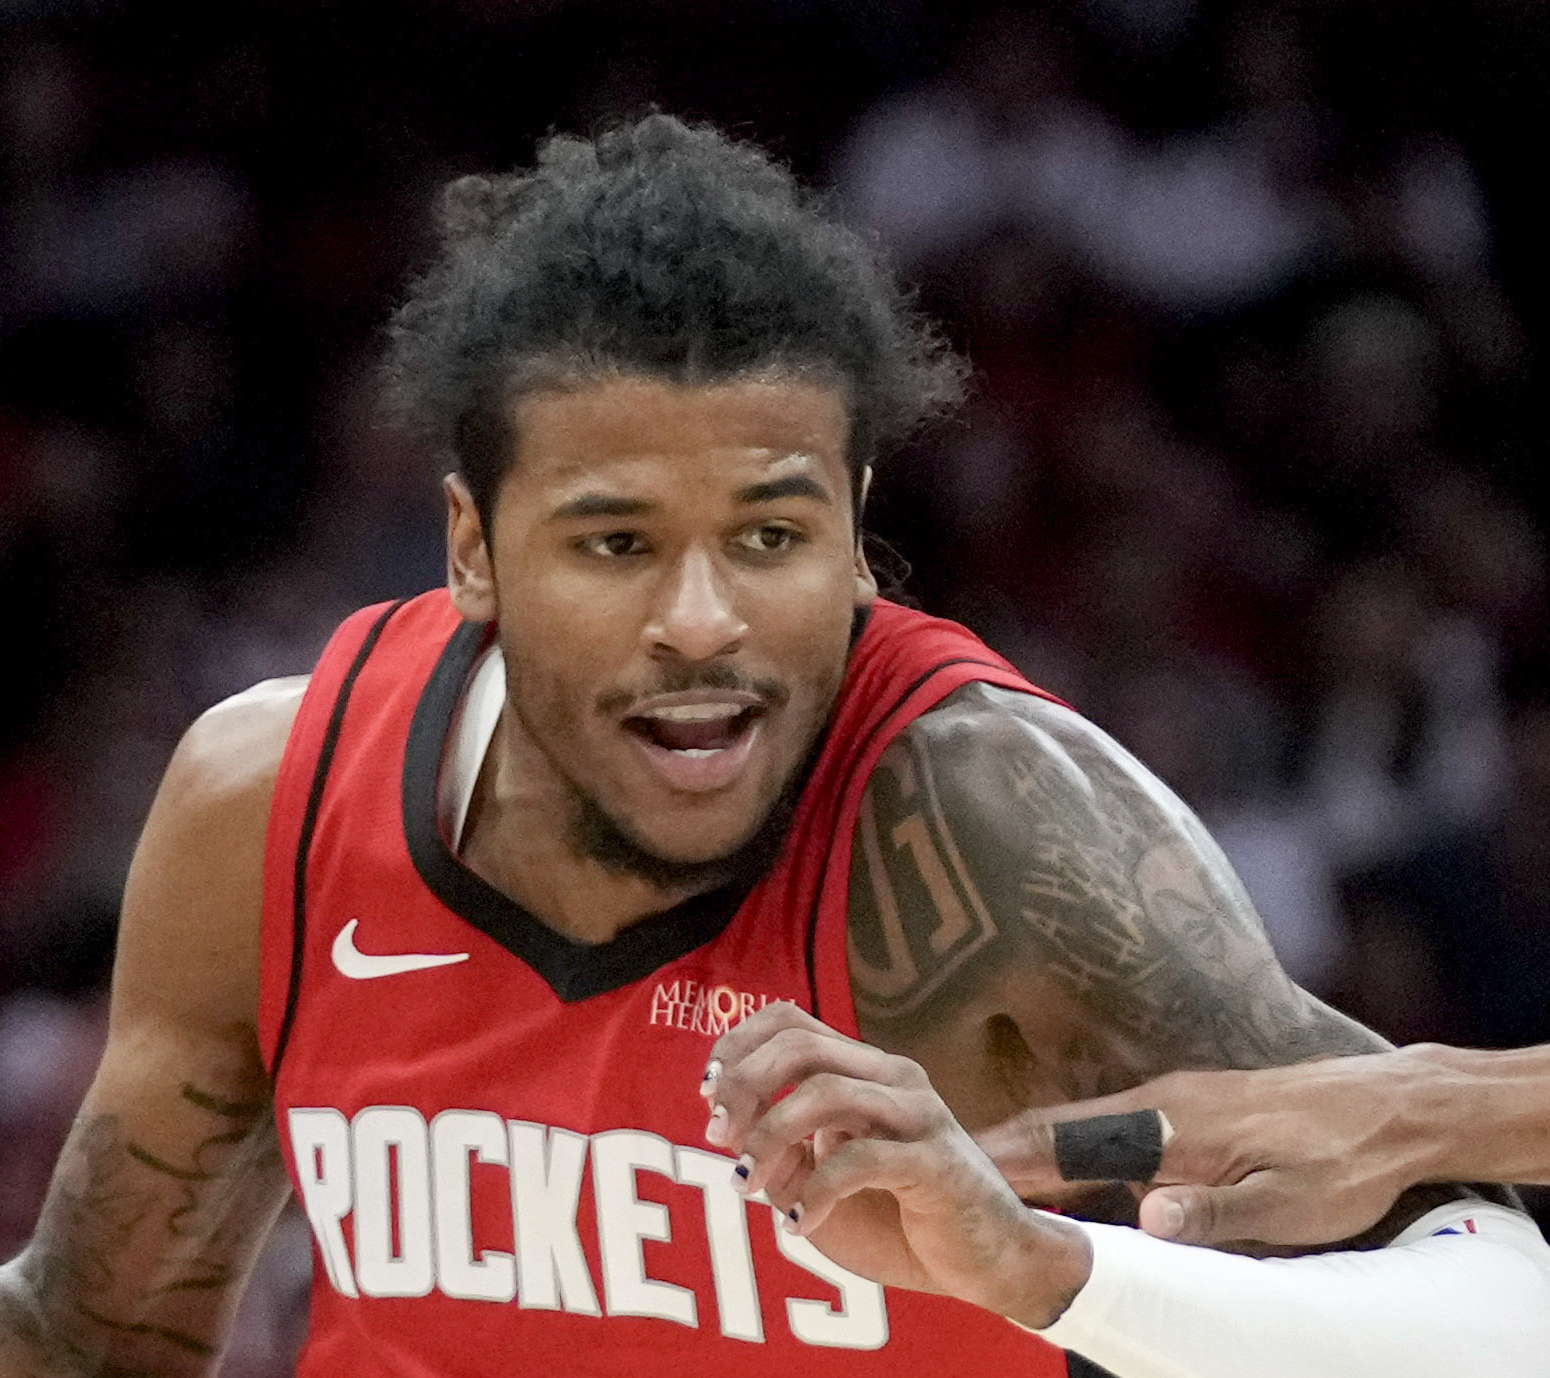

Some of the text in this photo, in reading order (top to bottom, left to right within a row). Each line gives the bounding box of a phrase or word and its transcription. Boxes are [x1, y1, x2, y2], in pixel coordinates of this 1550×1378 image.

[649, 999, 734, 1037] HERM
[651, 979, 797, 1021] MEMORI
[287, 1105, 891, 1351] ROCKETS
